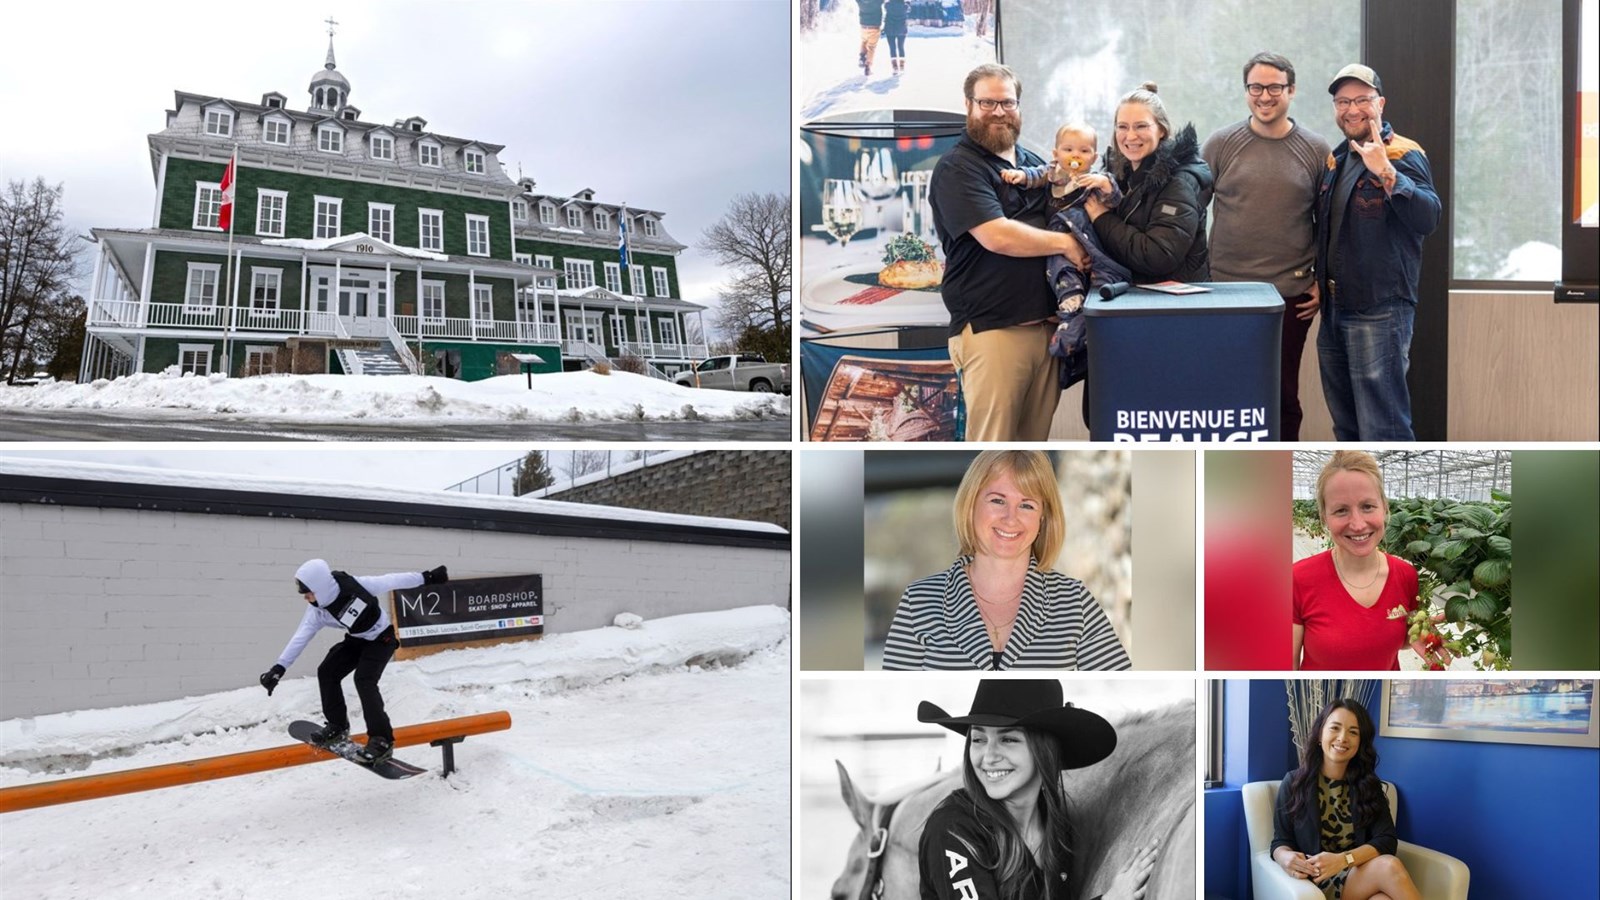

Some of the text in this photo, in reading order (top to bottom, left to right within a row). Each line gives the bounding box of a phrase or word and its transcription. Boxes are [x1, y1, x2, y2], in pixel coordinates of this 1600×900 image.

[356, 244, 374, 253] 1910
[1117, 407, 1265, 429] BIENVENUE EN
[401, 591, 441, 617] M2
[468, 591, 535, 605] BOARDSHOP
[347, 606, 359, 617] 5
[468, 604, 487, 612] SKATE
[511, 601, 537, 609] APPAREL
